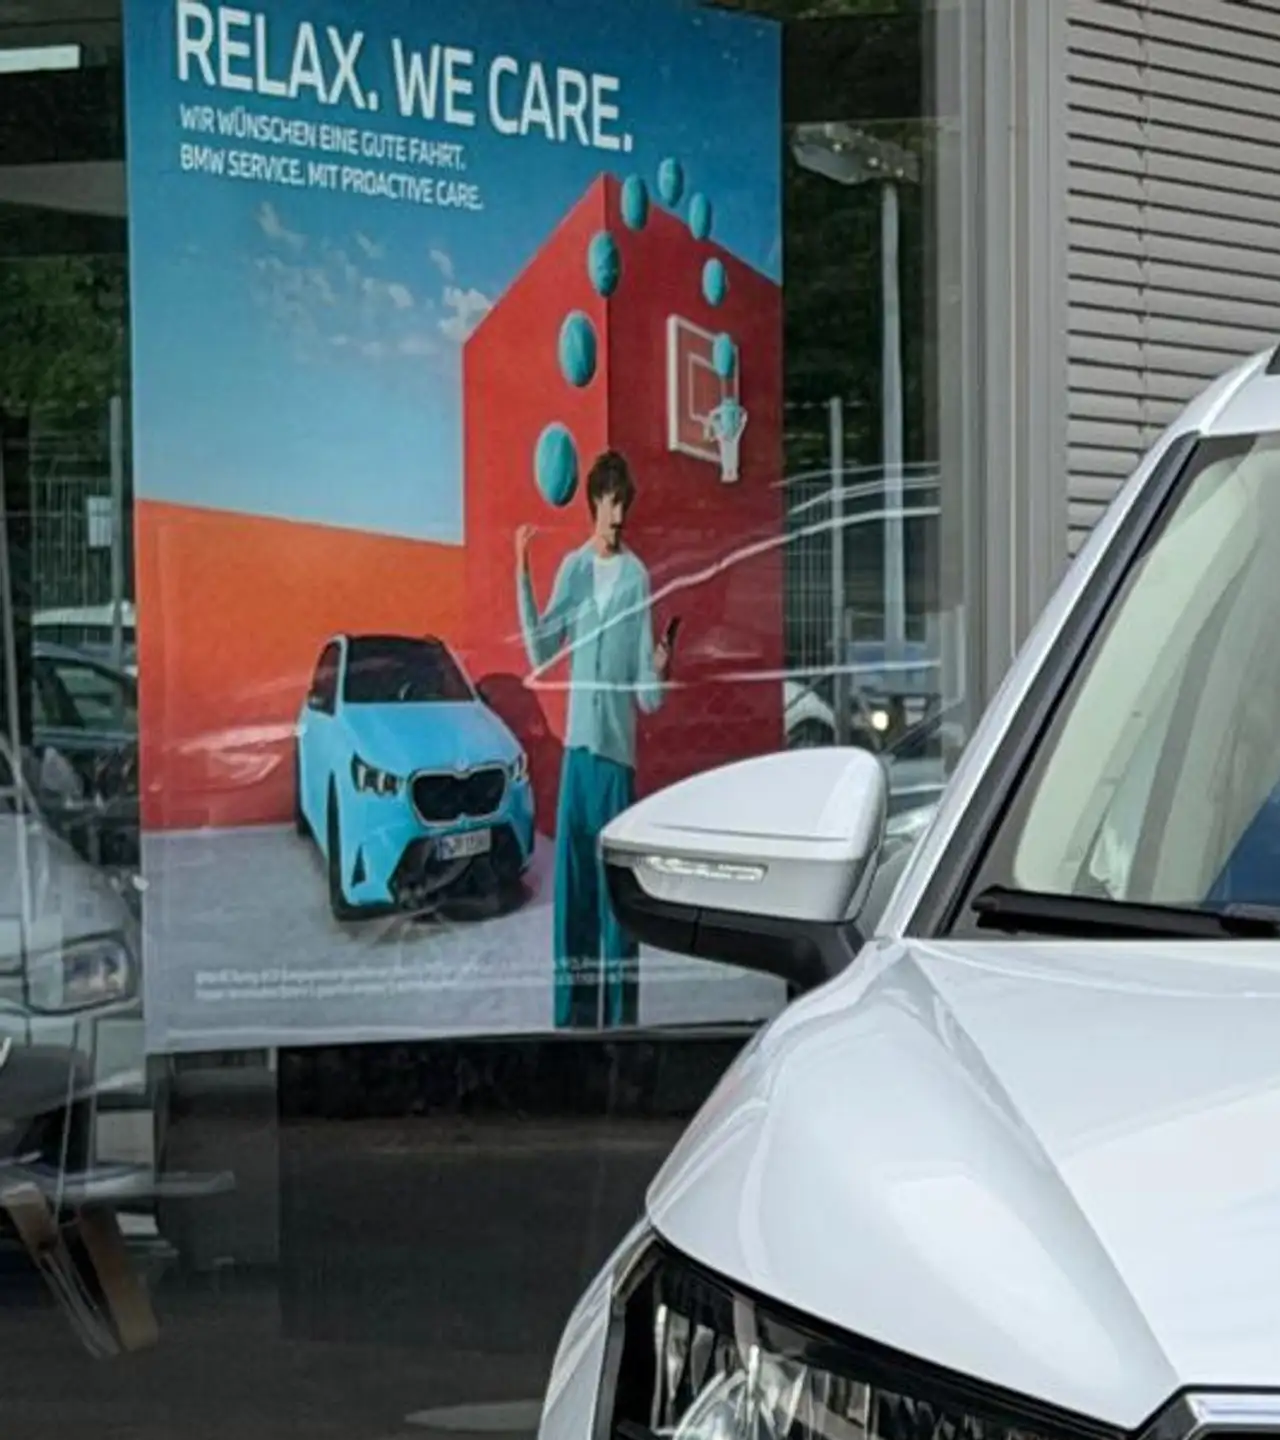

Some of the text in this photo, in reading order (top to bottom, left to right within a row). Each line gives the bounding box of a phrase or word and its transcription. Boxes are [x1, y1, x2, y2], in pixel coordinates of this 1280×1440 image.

[176, 0, 634, 153] RELAX. WE CARE.
[180, 103, 467, 171] WIR WÜNSCHEN EINE GUTE FAHRT.
[180, 143, 486, 211] BMW SERVICE. MIT PROACTIVE CARE.
